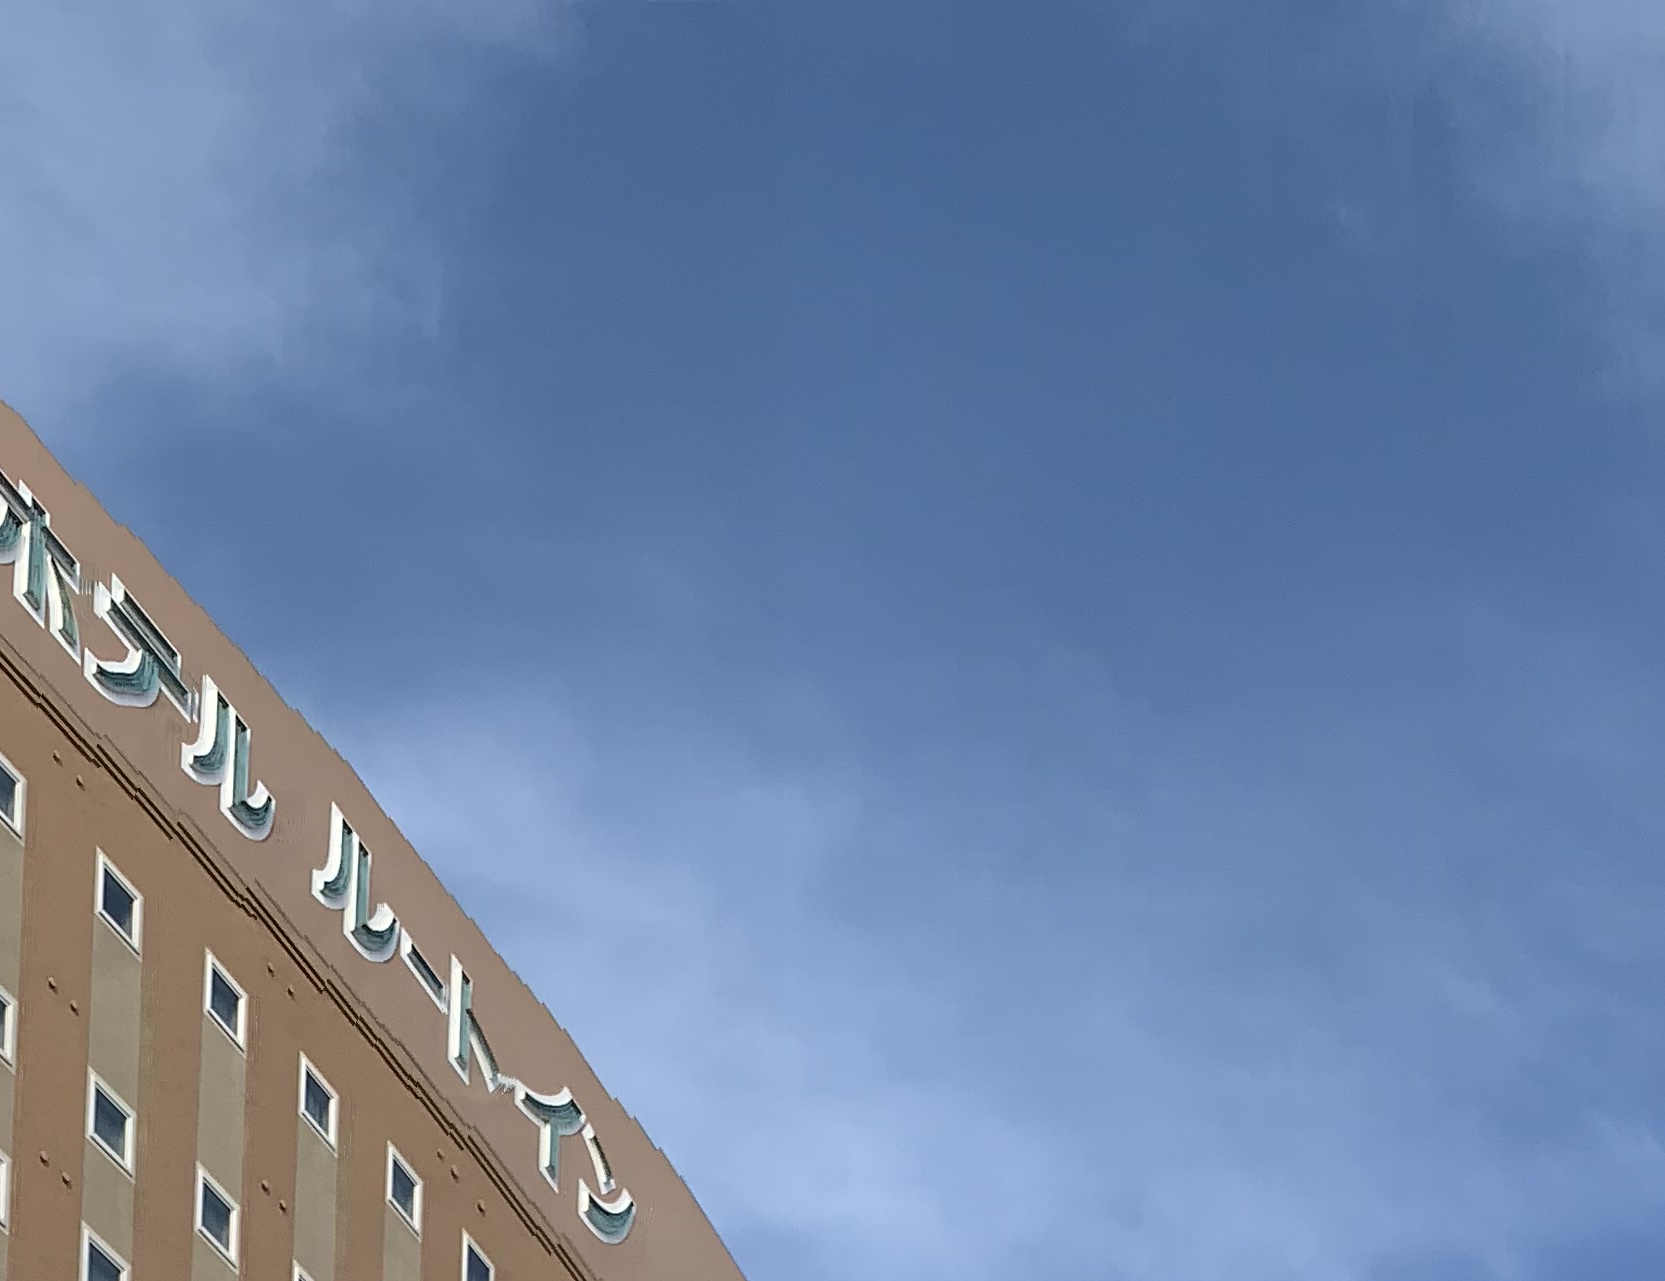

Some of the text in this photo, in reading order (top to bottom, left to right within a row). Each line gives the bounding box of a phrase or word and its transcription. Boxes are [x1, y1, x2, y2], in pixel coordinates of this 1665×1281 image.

[311, 800, 637, 1245] ルートイン
